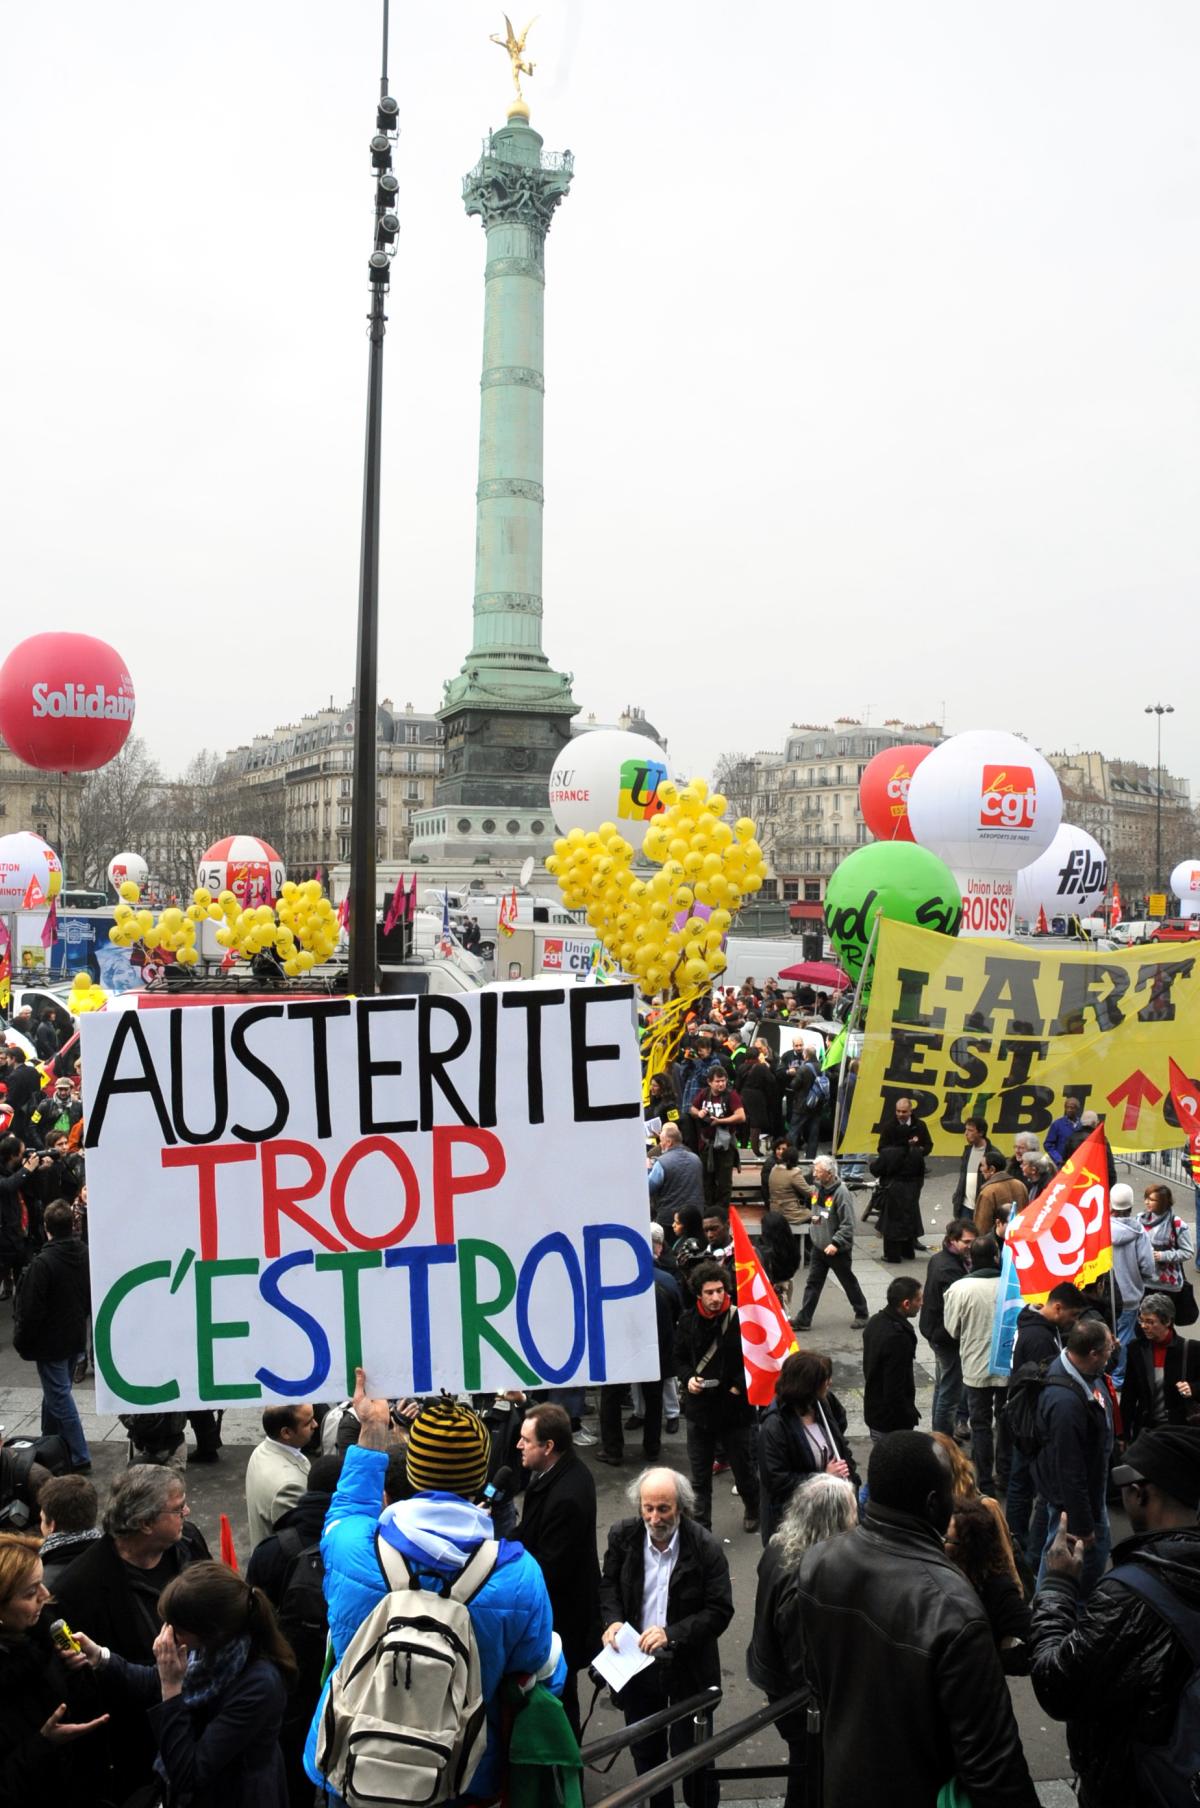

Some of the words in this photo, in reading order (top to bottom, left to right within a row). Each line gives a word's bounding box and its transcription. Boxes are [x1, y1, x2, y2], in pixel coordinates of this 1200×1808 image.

[887, 779, 911, 801] cg
[983, 772, 1030, 794] la
[556, 790, 590, 801] FRANCE
[980, 787, 1039, 826] cgt
[199, 869, 221, 889] 95
[967, 878, 991, 895] Union
[993, 879, 1013, 896] Locale
[961, 896, 1015, 935] ROISSY
[564, 941, 590, 954] Unio
[569, 954, 592, 970] CR
[85, 984, 641, 1149] AUSTERITE
[884, 1027, 1050, 1089] EST
[160, 1125, 506, 1261] TROP
[95, 1248, 383, 1406] C'EST
[384, 1223, 654, 1392] TROP
